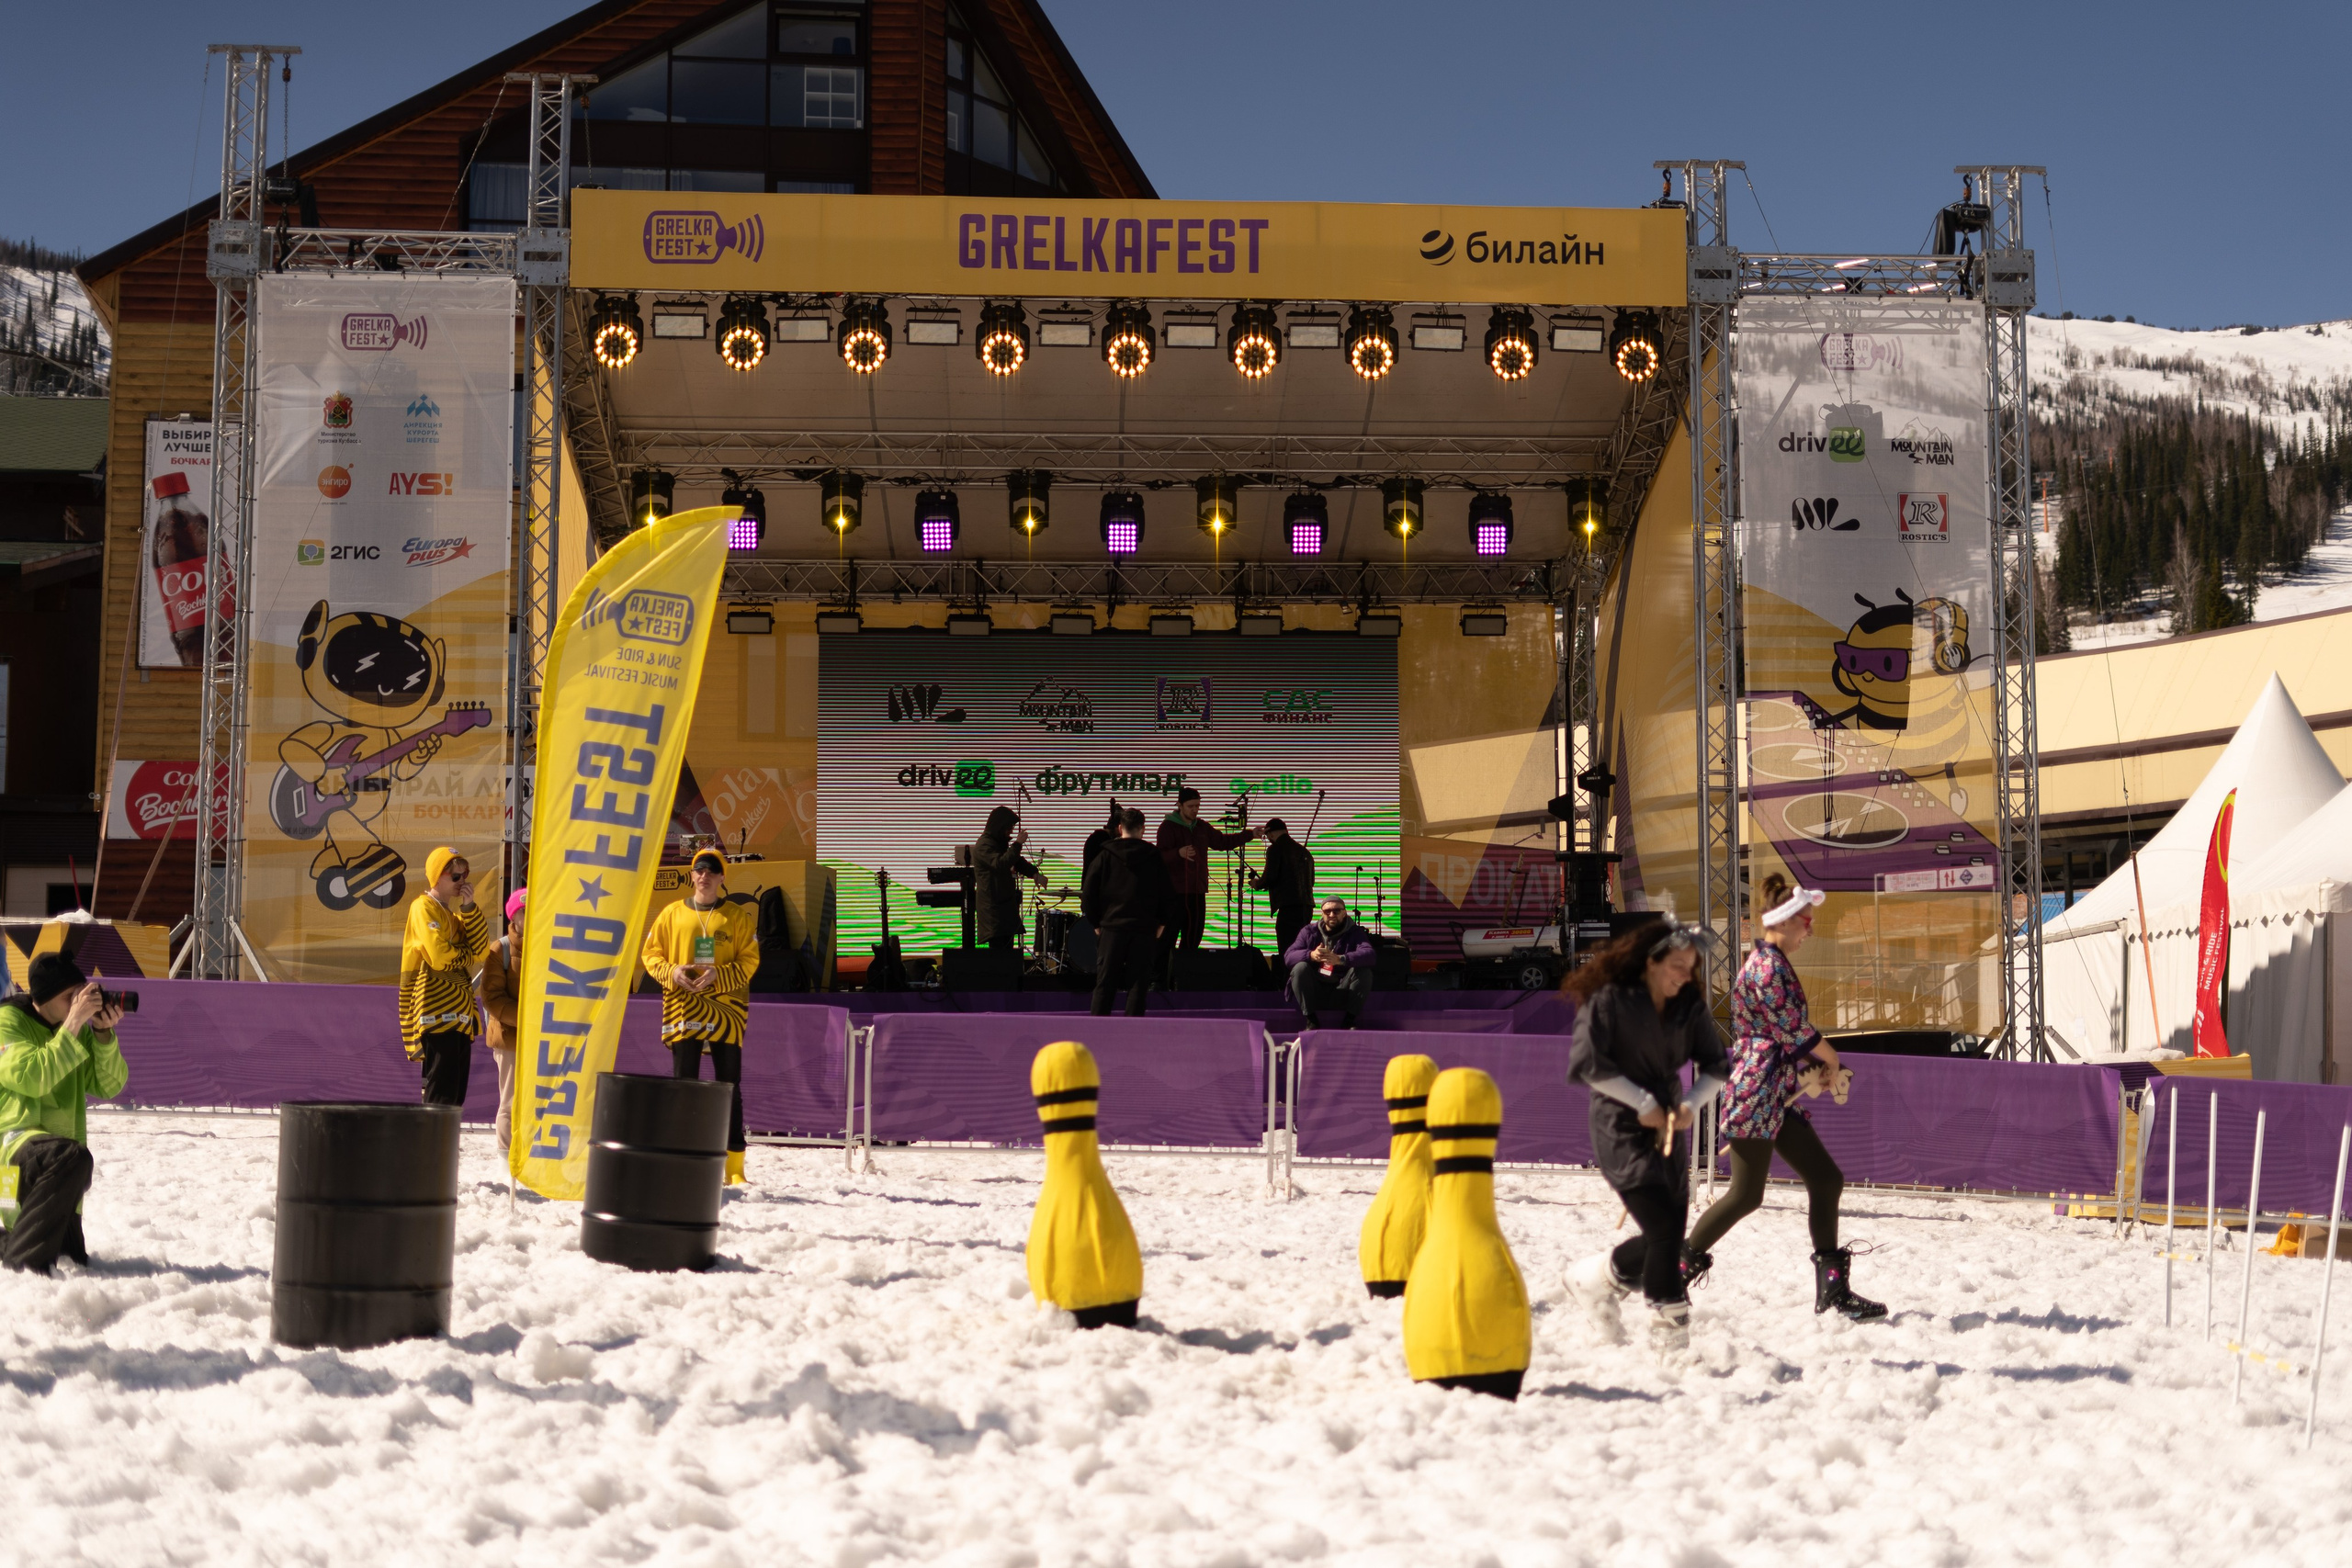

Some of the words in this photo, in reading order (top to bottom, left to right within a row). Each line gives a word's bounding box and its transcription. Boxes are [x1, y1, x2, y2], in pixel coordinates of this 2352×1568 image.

[656, 219, 713, 236] GRELKA
[655, 239, 694, 256] FEST
[959, 213, 1269, 275] GRELKAFEST
[1466, 231, 1604, 265] билайн
[350, 319, 390, 332] GRELKA
[349, 333, 378, 345] FEST
[1829, 339, 1869, 351] GRELKA
[163, 430, 229, 441] ВЫБИР
[1779, 432, 1865, 457] drivee
[1891, 441, 1953, 454] MOUNTAIN
[171, 457, 218, 466] БОЧКАР
[1926, 454, 1954, 465] MAN
[322, 478, 348, 488] энгиро
[389, 472, 454, 496] AYS!
[1902, 533, 1947, 541] ROSTIC'S
[330, 546, 380, 560] 2ГИС
[1261, 689, 1333, 713] СДС
[1019, 704, 1092, 717] MOUNTAIN
[1262, 713, 1333, 724] ФИНАНС
[1059, 719, 1093, 733] MAN
[898, 764, 995, 791] drivee
[1035, 767, 1183, 795] фрутилад
[414, 804, 514, 820] БОЧКАРИ
[656, 872, 676, 880] GRELKA
[1419, 852, 1559, 910] ПРОКАТ
[2205, 931, 2218, 956] RIDE
[2204, 958, 2218, 990] MUSIC
